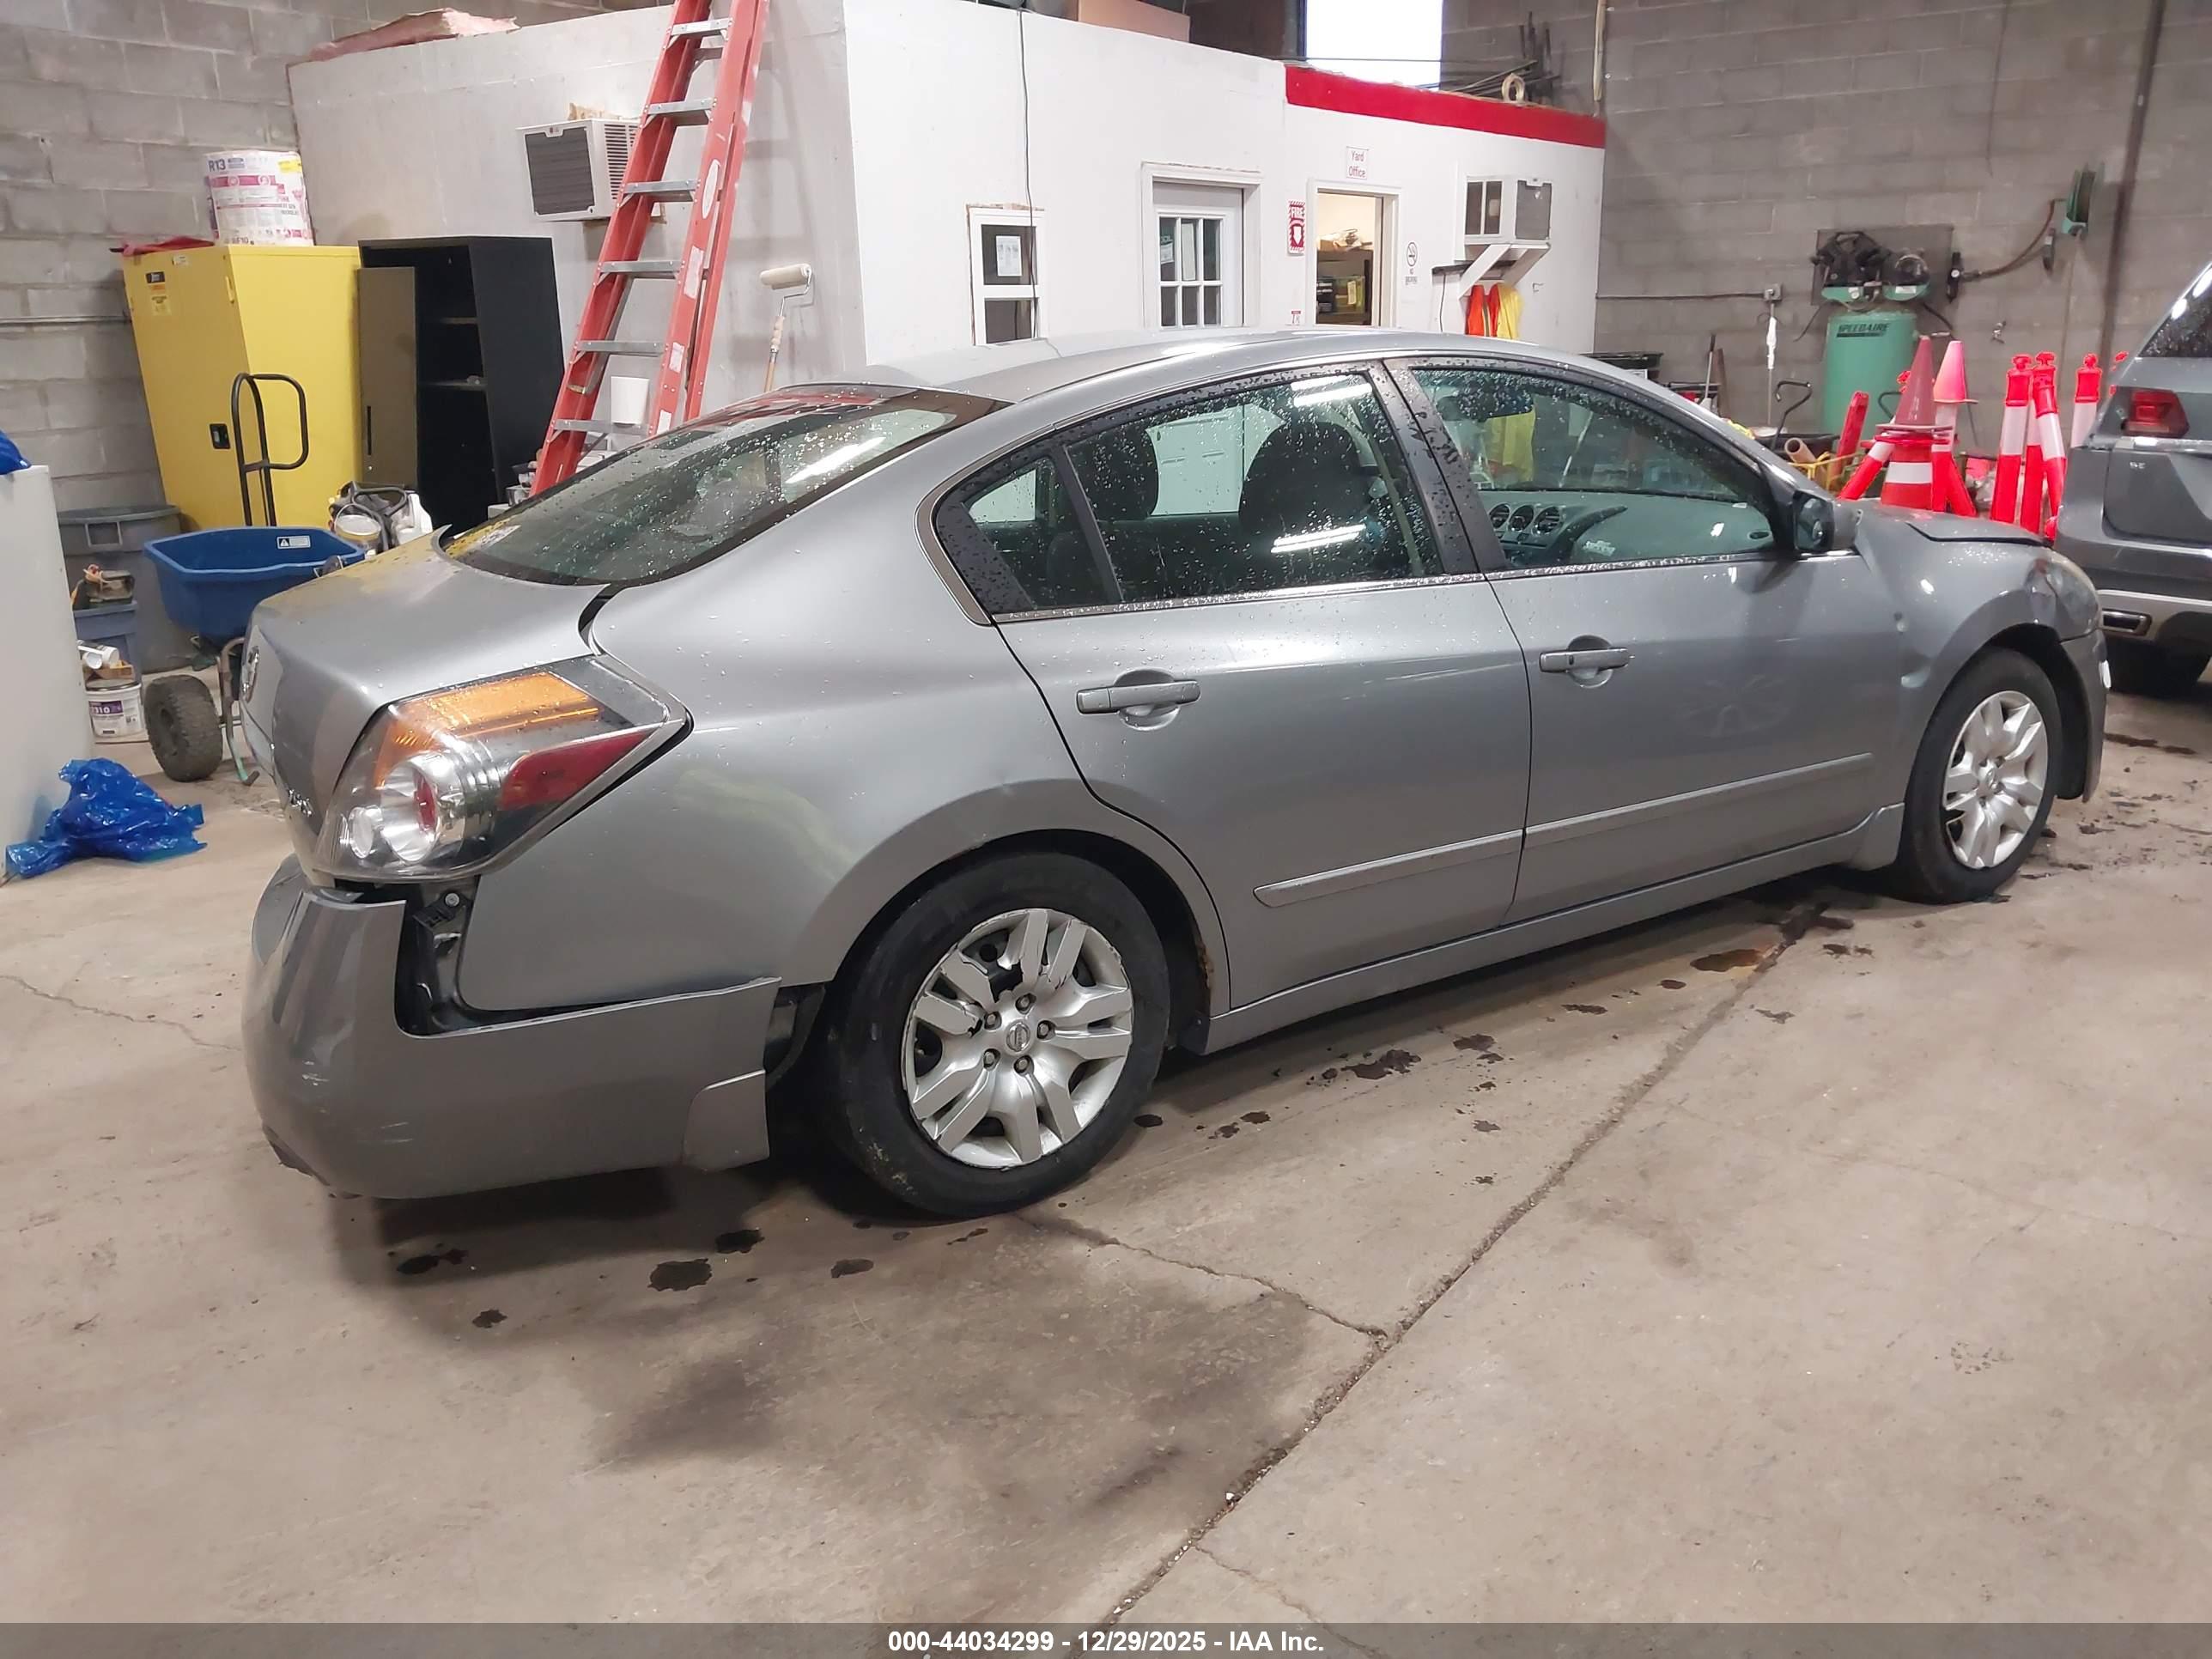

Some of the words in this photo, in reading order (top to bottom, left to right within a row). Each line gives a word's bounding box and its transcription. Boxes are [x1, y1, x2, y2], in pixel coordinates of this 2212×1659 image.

[1351, 151, 1364, 162] Yard
[208, 158, 227, 173] R13
[1348, 166, 1366, 179] Office
[1291, 206, 1304, 219] FIRE
